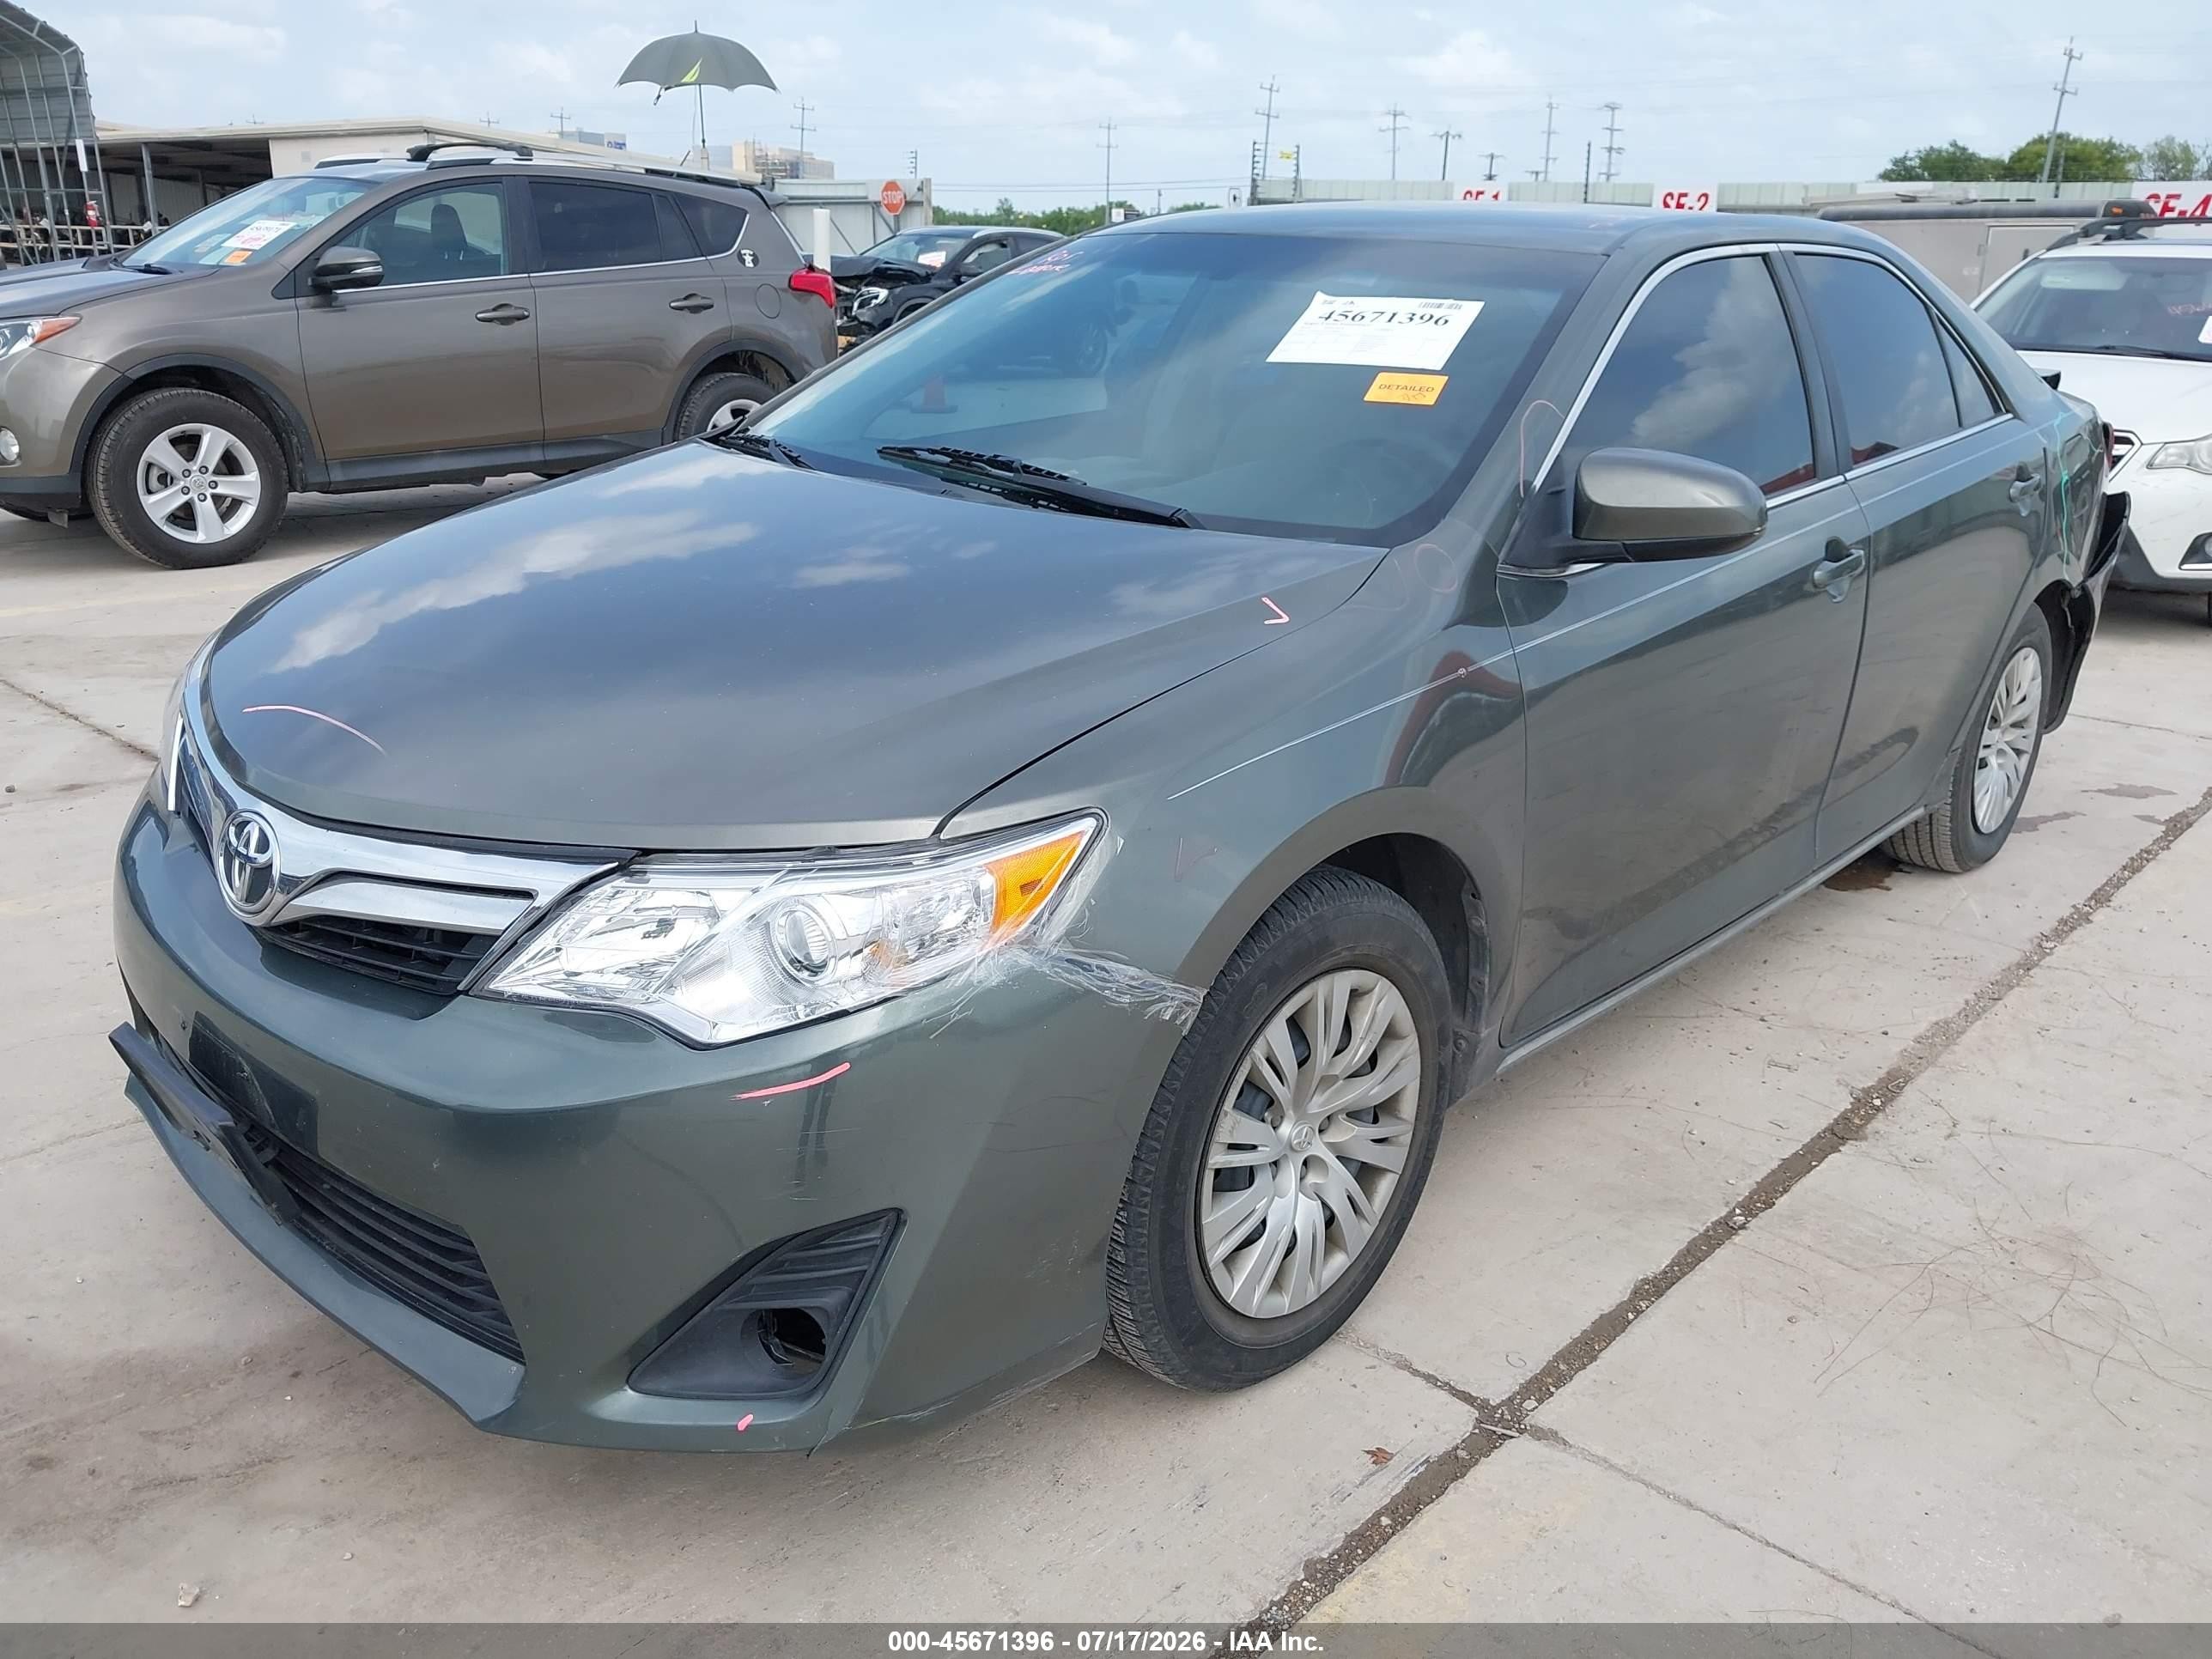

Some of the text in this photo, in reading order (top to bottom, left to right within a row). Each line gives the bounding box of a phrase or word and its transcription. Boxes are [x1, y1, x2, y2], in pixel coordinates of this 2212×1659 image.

[883, 191, 902, 204] STOP
[1318, 310, 1453, 326] 45671396
[1378, 383, 1435, 393] DETAILED
